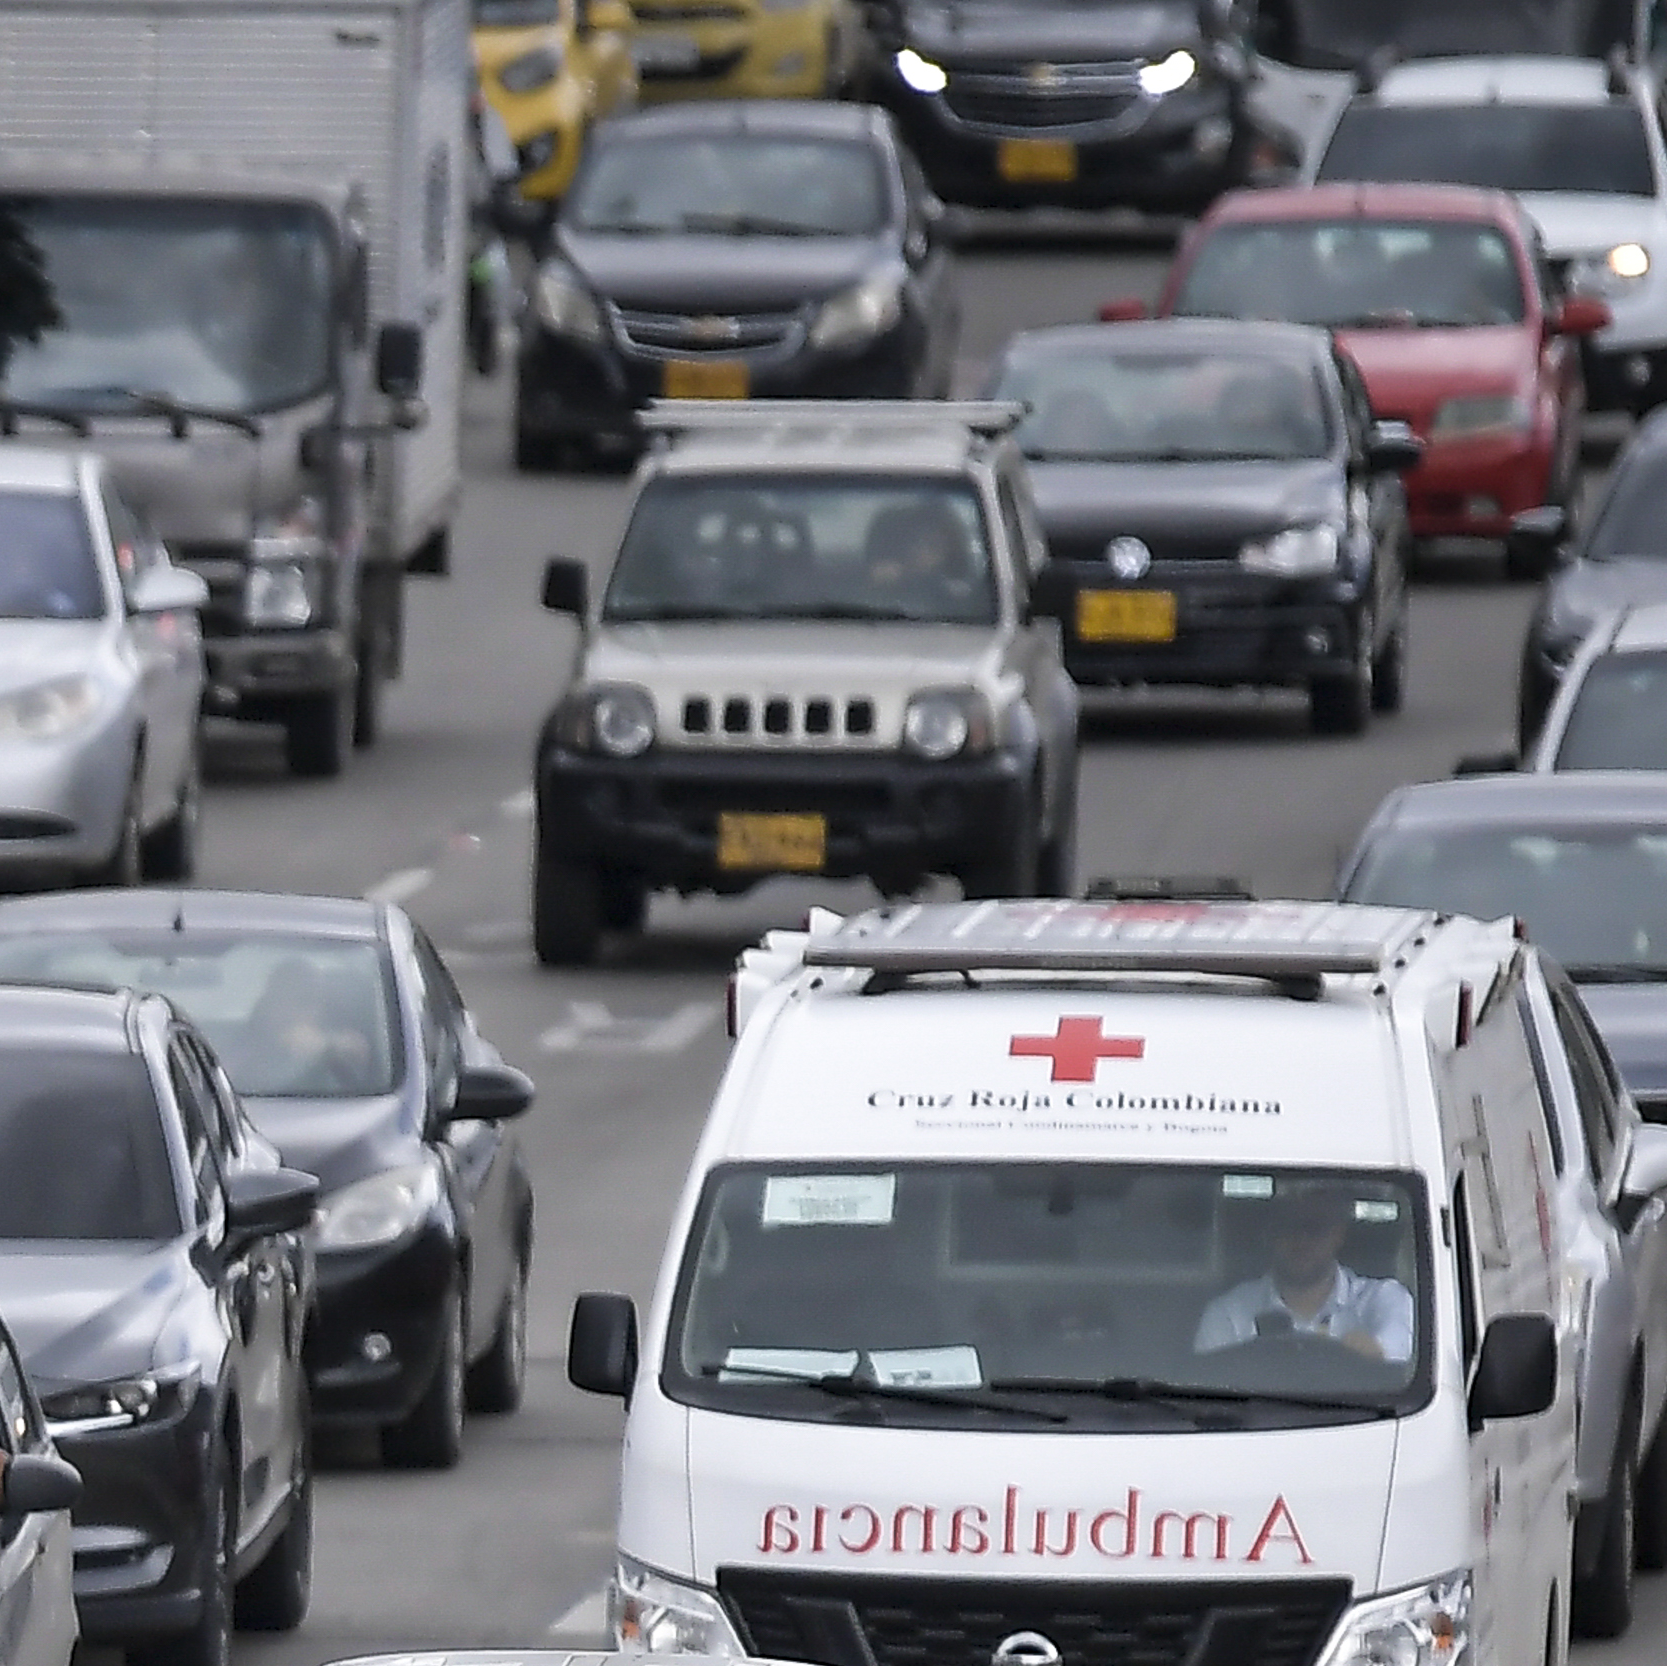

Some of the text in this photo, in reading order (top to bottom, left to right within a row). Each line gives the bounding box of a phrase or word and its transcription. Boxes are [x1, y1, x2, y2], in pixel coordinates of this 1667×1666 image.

[867, 1089, 1282, 1115] Cruz Roja Colombiana
